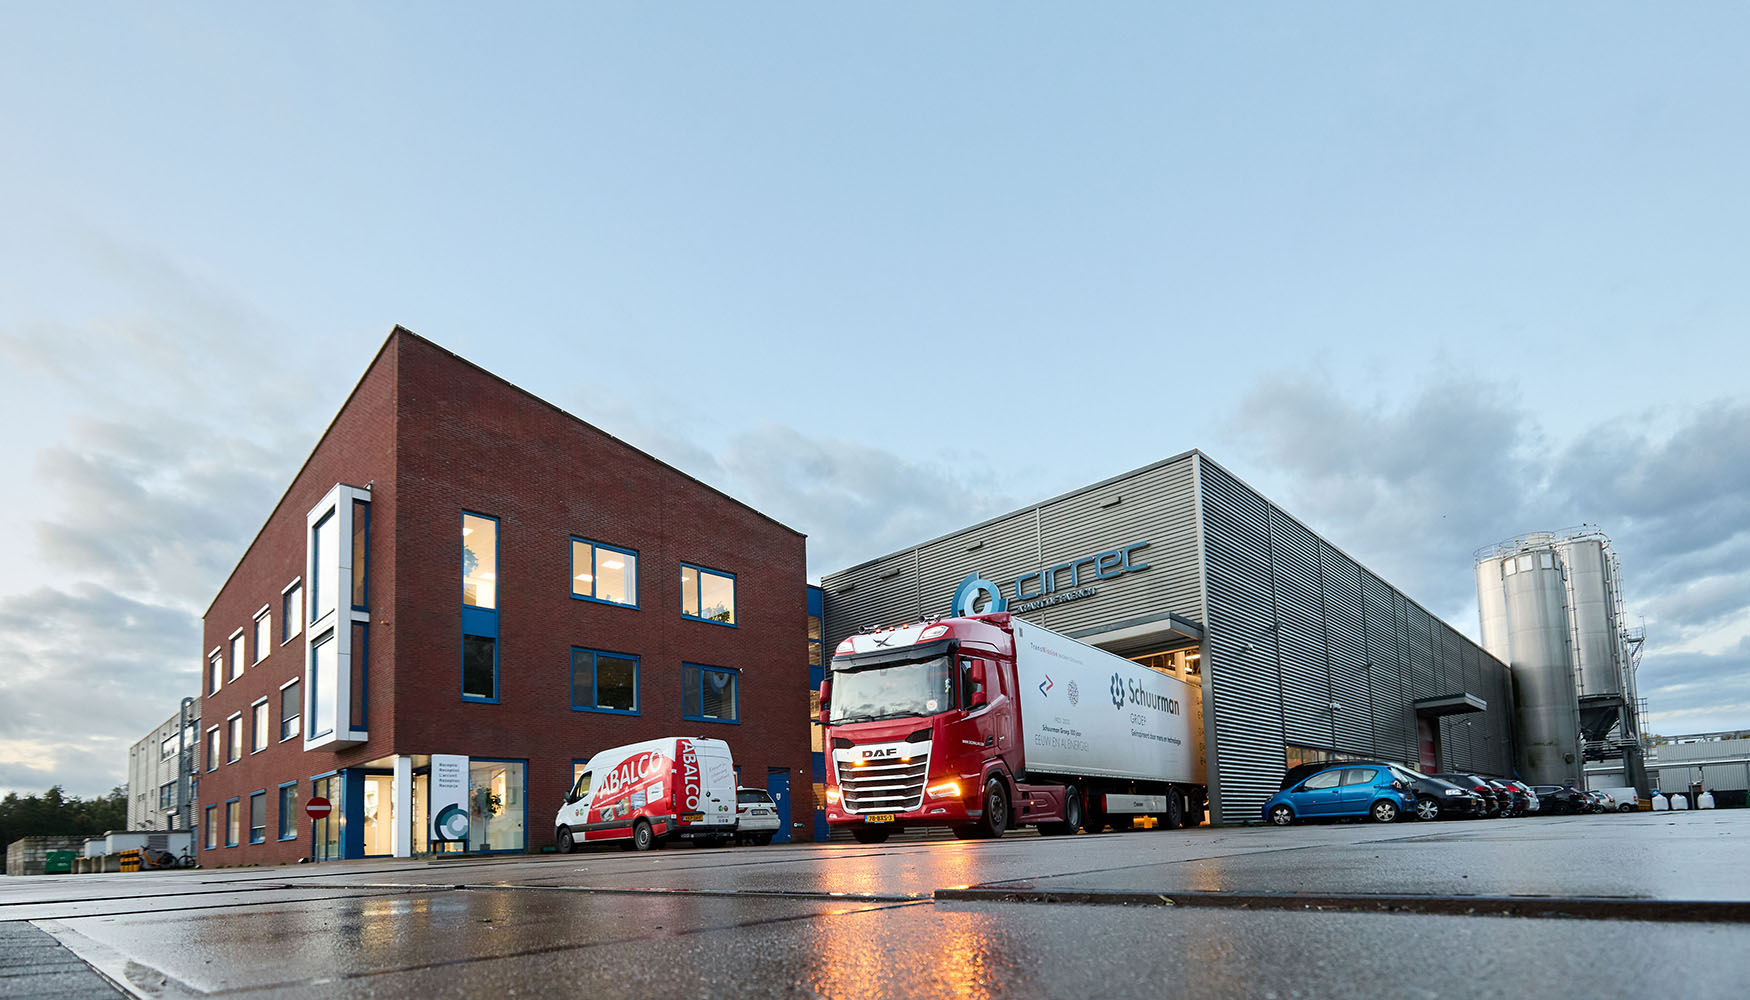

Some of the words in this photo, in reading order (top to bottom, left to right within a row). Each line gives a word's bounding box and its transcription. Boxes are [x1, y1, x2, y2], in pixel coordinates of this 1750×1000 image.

[1015, 540, 1149, 600] cirrec
[1128, 678, 1180, 716] Schuurman
[599, 750, 663, 800] ABALCO
[681, 741, 700, 810] ABALCO
[862, 748, 897, 758] DAF
